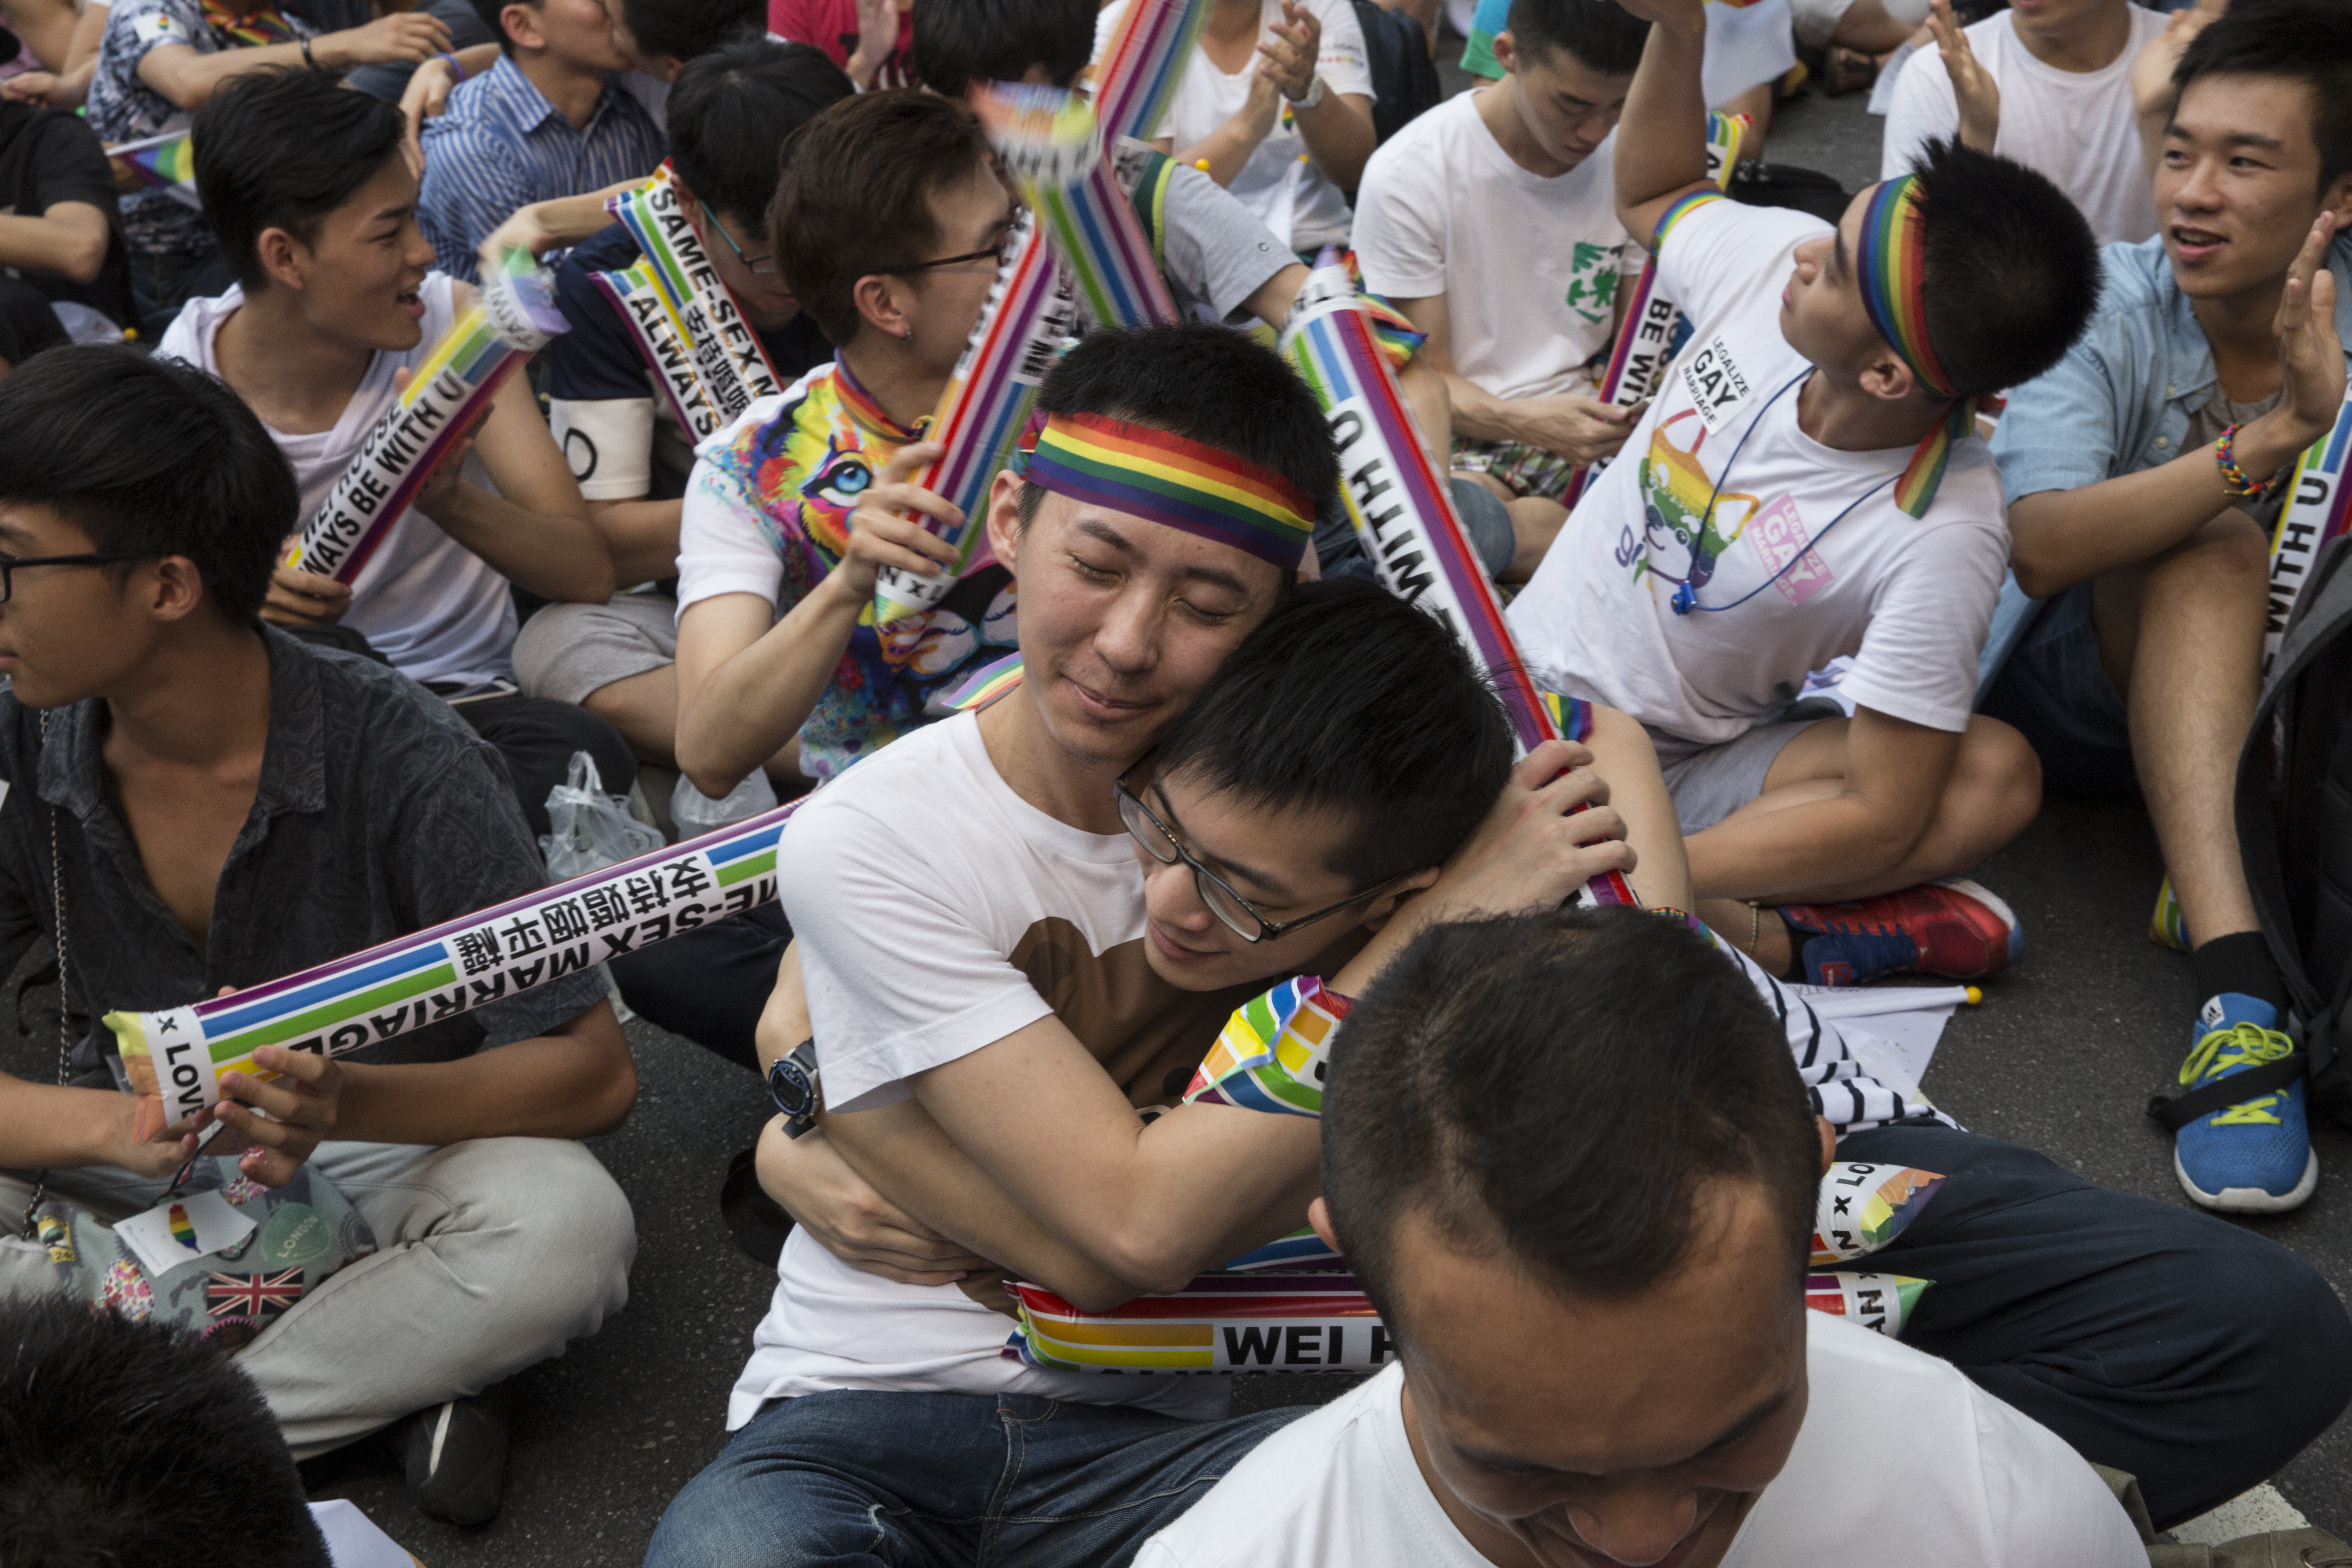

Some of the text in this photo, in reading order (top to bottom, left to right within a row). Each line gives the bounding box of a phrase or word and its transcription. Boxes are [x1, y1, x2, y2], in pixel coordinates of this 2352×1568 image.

[651, 188, 763, 371] SAME-SEX
[1640, 298, 1673, 343] BE
[630, 297, 721, 435] ALWAYS
[1618, 354, 1657, 409] WIT
[1683, 366, 1717, 425] MARRIAGE
[1694, 350, 1740, 408] GAY
[1713, 336, 1750, 397] LEGALIZE
[299, 370, 467, 576] WAYS BE WITH U
[2296, 477, 2329, 506] U
[1351, 458, 1437, 605] WITH
[1764, 514, 1816, 584] GAY
[453, 856, 711, 976] 支持婚姻平權
[1223, 1325, 1343, 1365] WEI
